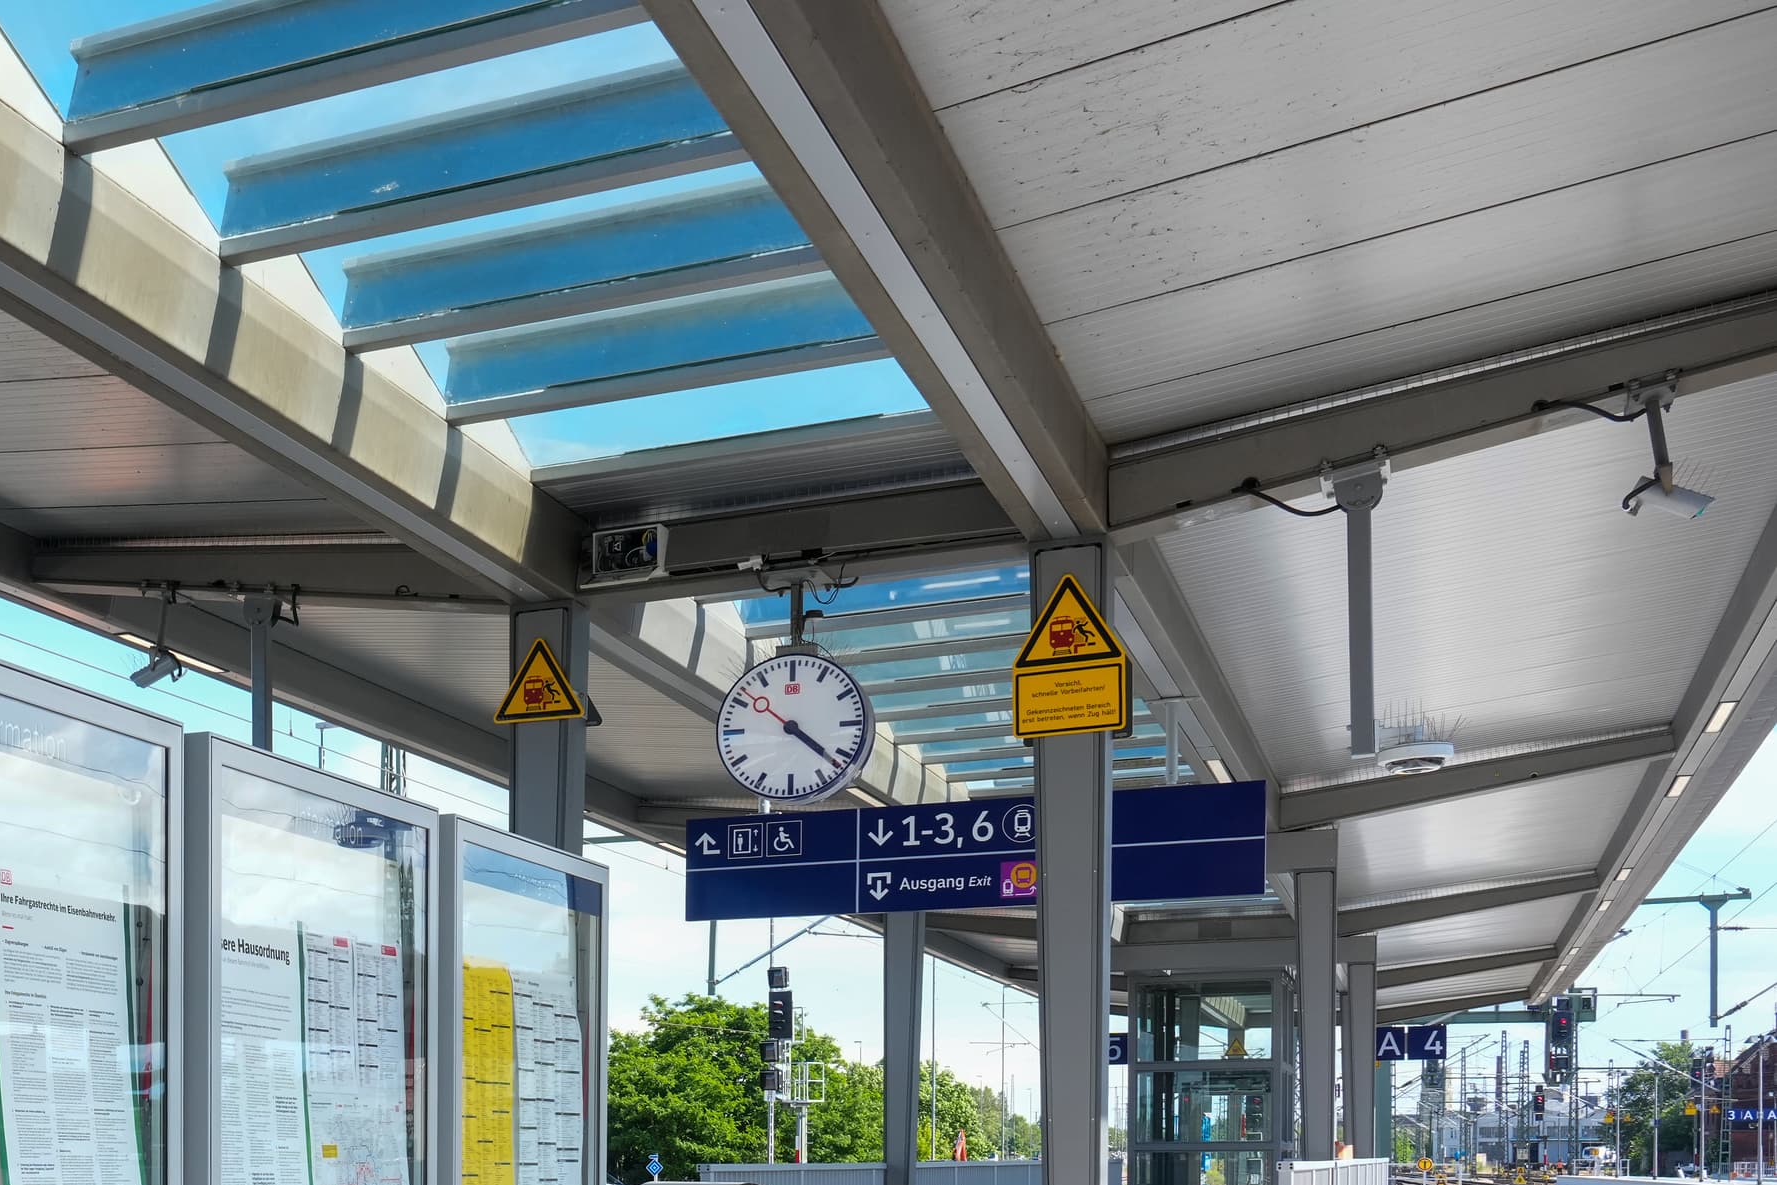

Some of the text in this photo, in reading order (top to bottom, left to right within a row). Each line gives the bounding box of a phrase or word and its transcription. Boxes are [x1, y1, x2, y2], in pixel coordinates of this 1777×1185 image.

[1031, 690, 1058, 698] schnelle
[1086, 702, 1110, 710] Bereich
[901, 810, 994, 849] 1-3, 6
[899, 875, 992, 892] Ausgang Exit
[0, 893, 117, 922] Ihre Fahrgastrechte im Eisenbahnverkehr.
[237, 938, 291, 966] Hausordnung
[1378, 1031, 1443, 1056] A 4
[1727, 1109, 1777, 1120] 3 A A
